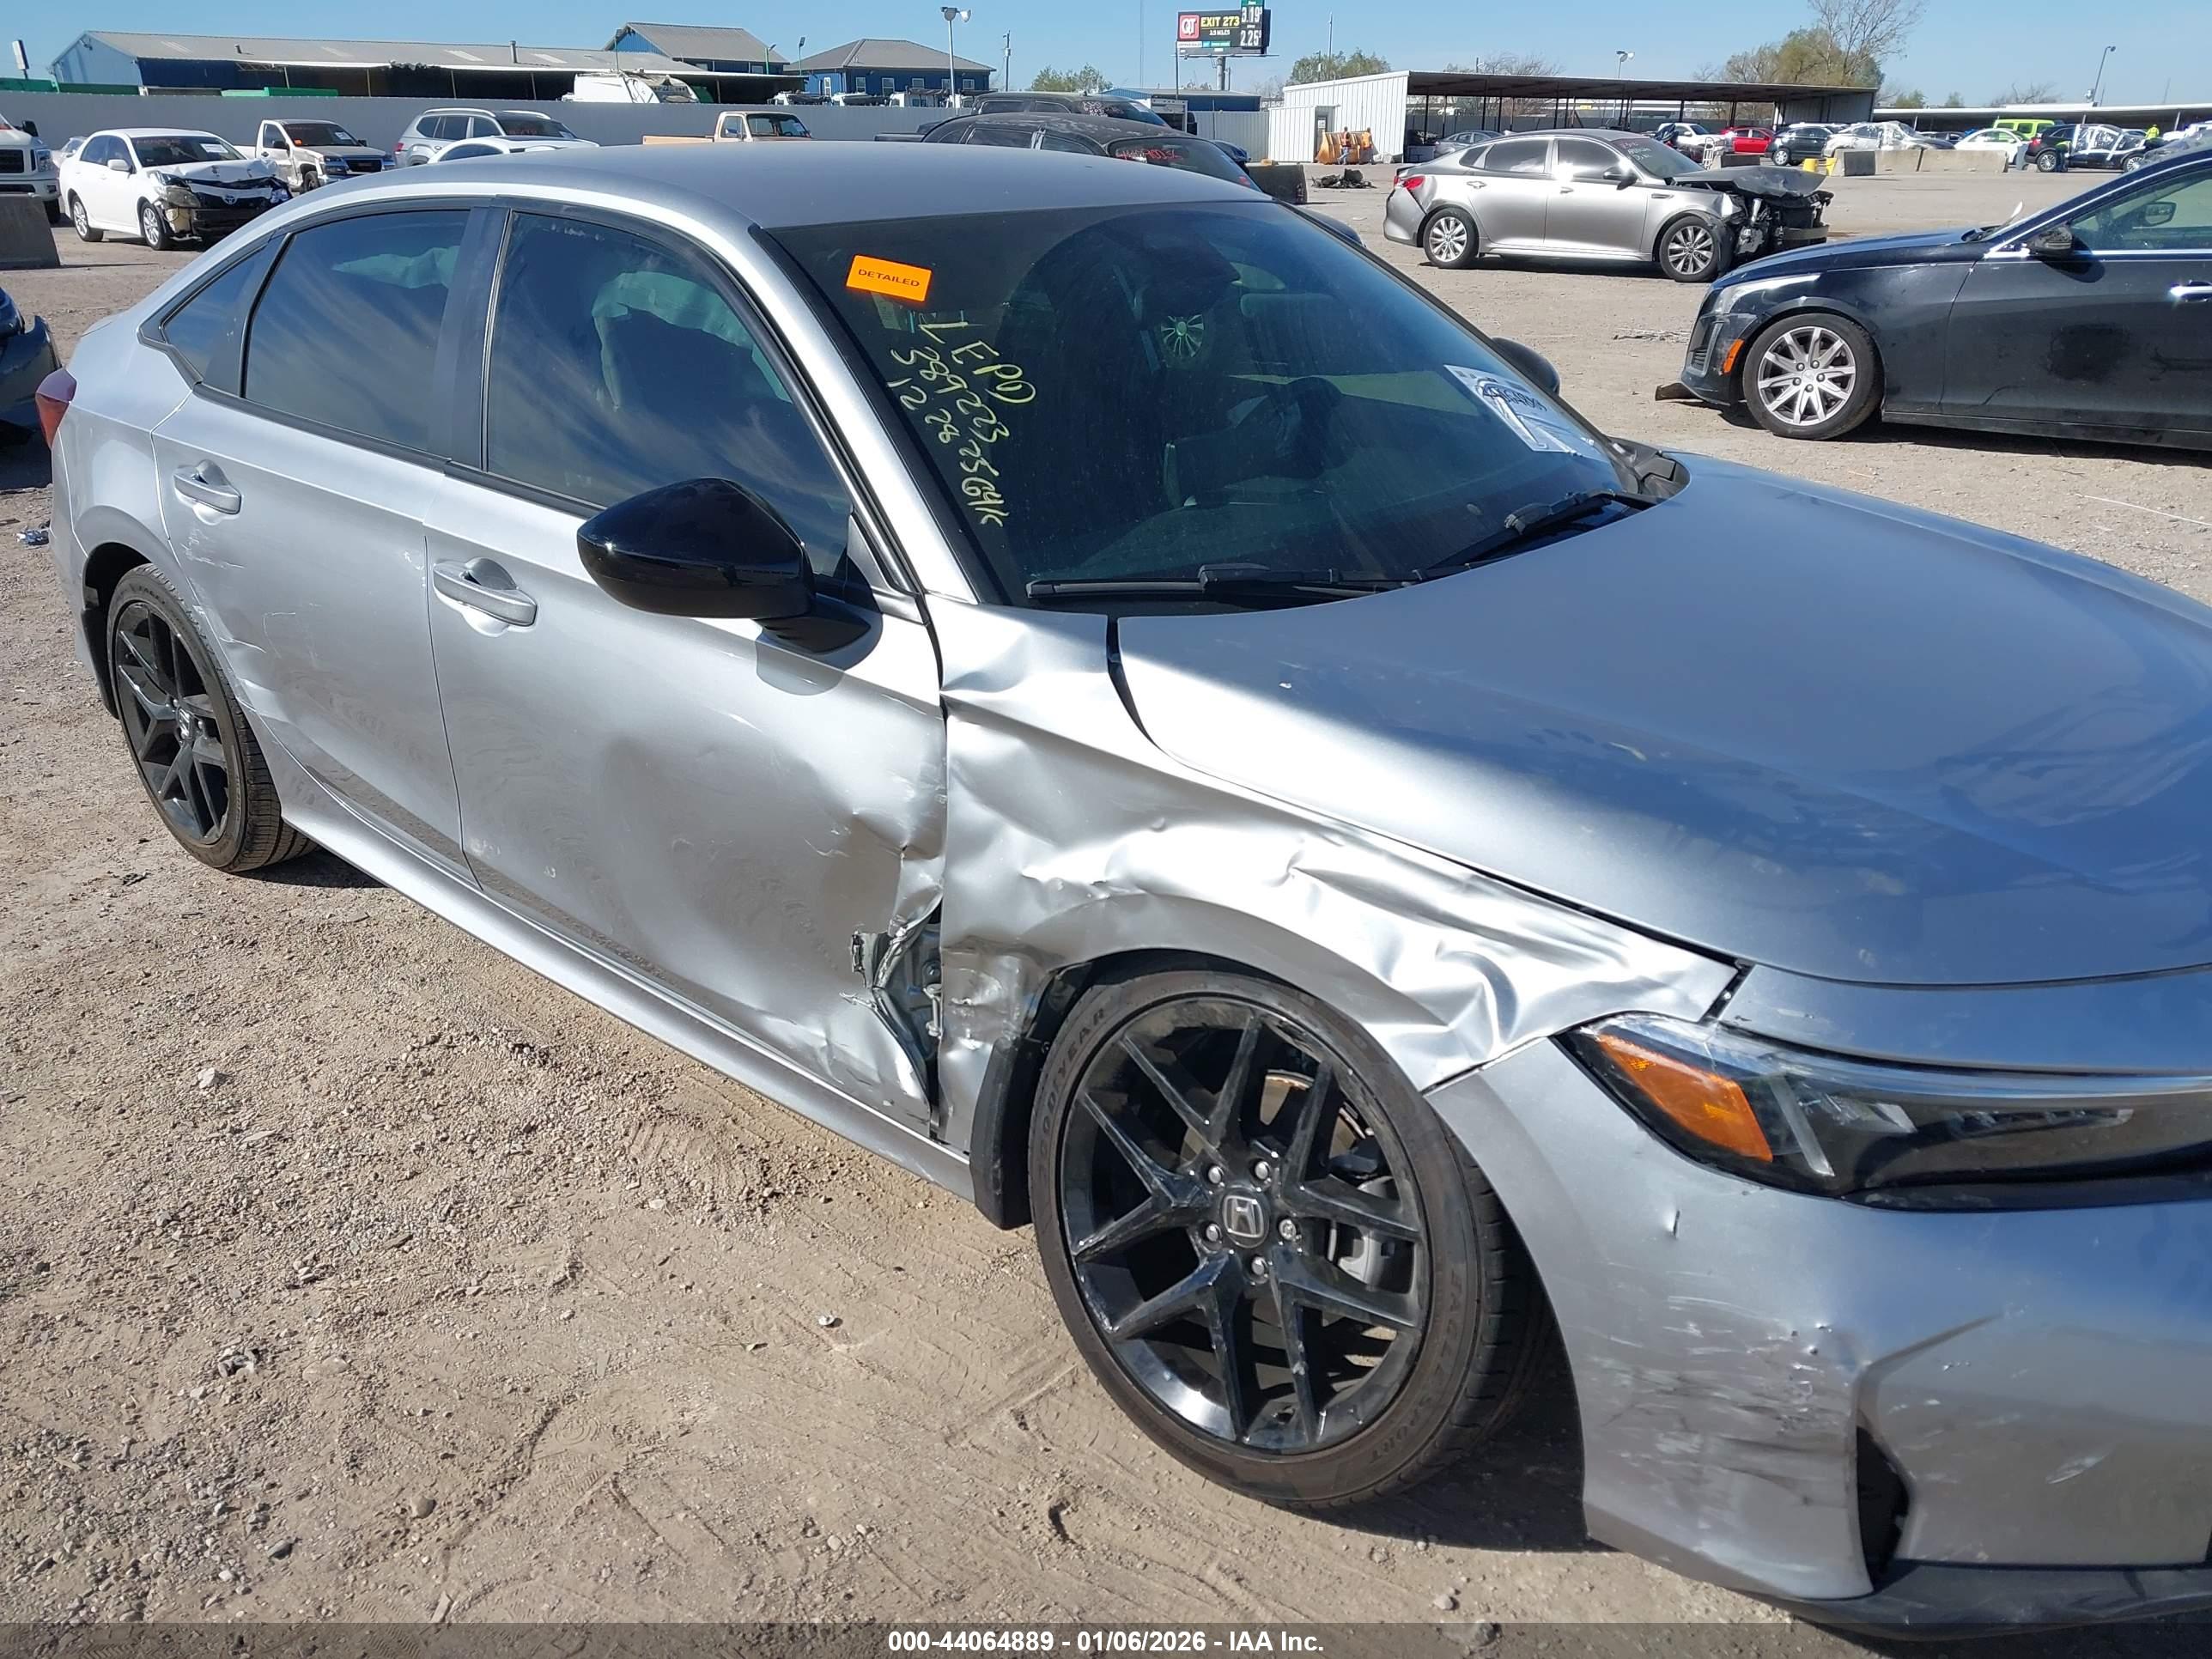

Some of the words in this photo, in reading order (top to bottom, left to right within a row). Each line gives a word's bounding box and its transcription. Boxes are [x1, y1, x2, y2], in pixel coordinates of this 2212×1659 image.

[1181, 17, 1196, 35] QT
[1200, 16, 1221, 27] EXIT
[1222, 15, 1240, 27] 273
[858, 269, 921, 287] DETAILED
[887, 377, 927, 411] 12
[924, 408, 961, 443] 28
[1036, 1004, 1109, 1184] GOODYEAR
